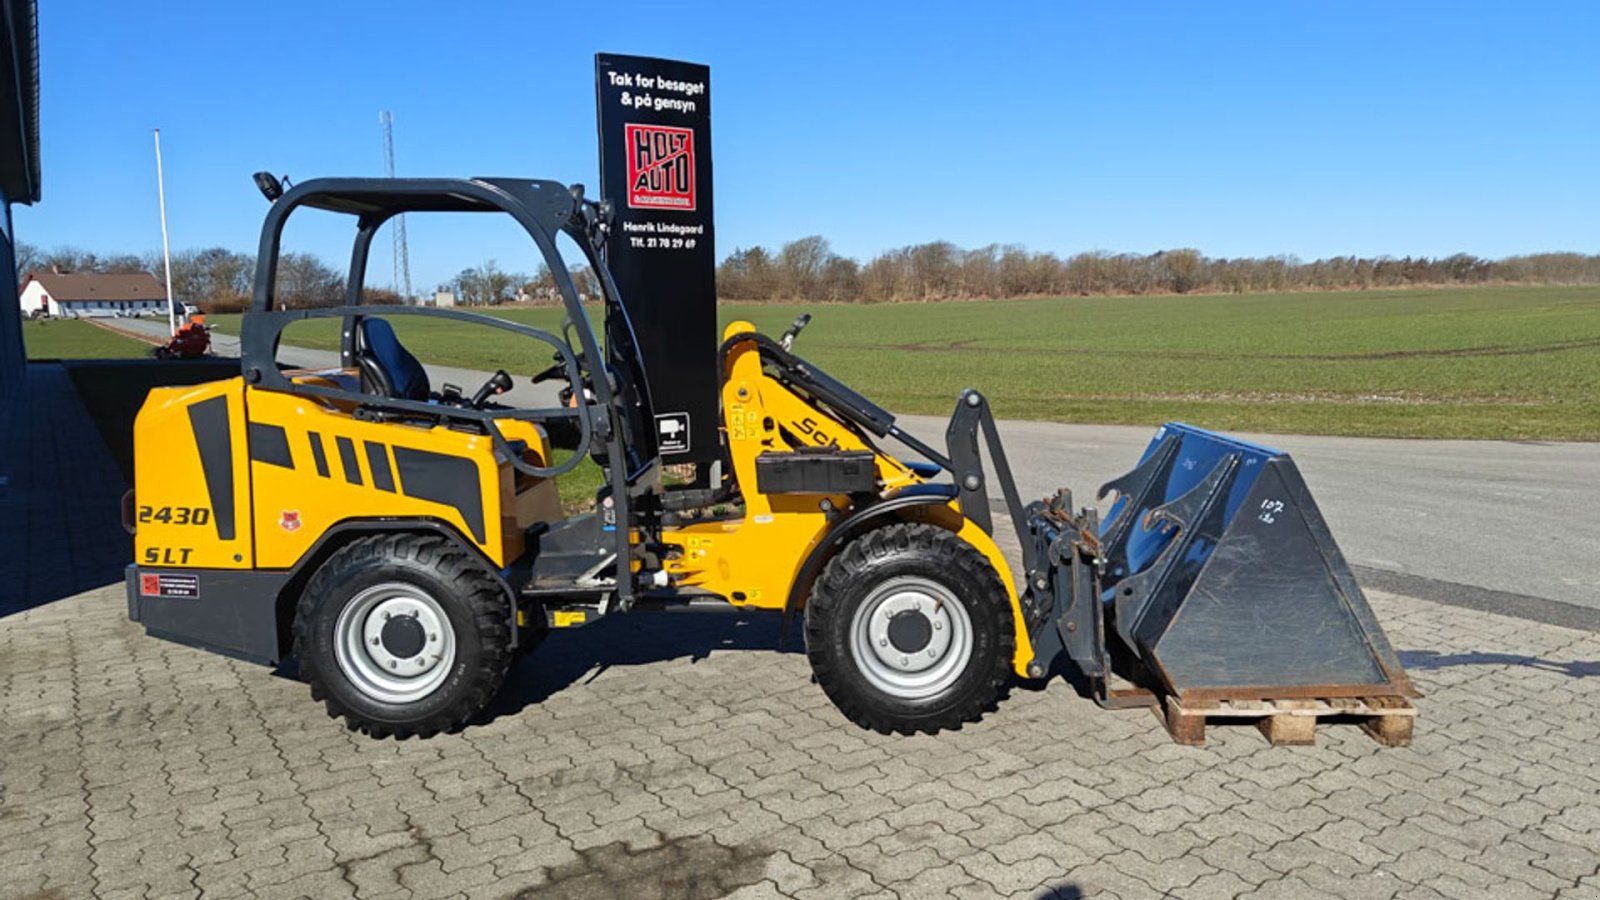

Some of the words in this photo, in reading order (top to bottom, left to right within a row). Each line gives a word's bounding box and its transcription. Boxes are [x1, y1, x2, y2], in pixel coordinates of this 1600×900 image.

[608, 71, 632, 86] Tak
[635, 73, 654, 88] for
[657, 75, 704, 96] besøget
[621, 91, 632, 105] &
[635, 93, 652, 110] på
[654, 97, 696, 114] gensyn
[634, 129, 687, 171] HOLT
[634, 153, 690, 193] AUTO
[623, 221, 655, 233] Henrik
[657, 222, 704, 235] Lindegaard
[647, 237, 657, 248] 21
[659, 238, 670, 248] 78
[672, 238, 683, 249] 29
[685, 239, 696, 249] 69
[139, 505, 210, 526] 2430
[144, 547, 194, 564] SLT
